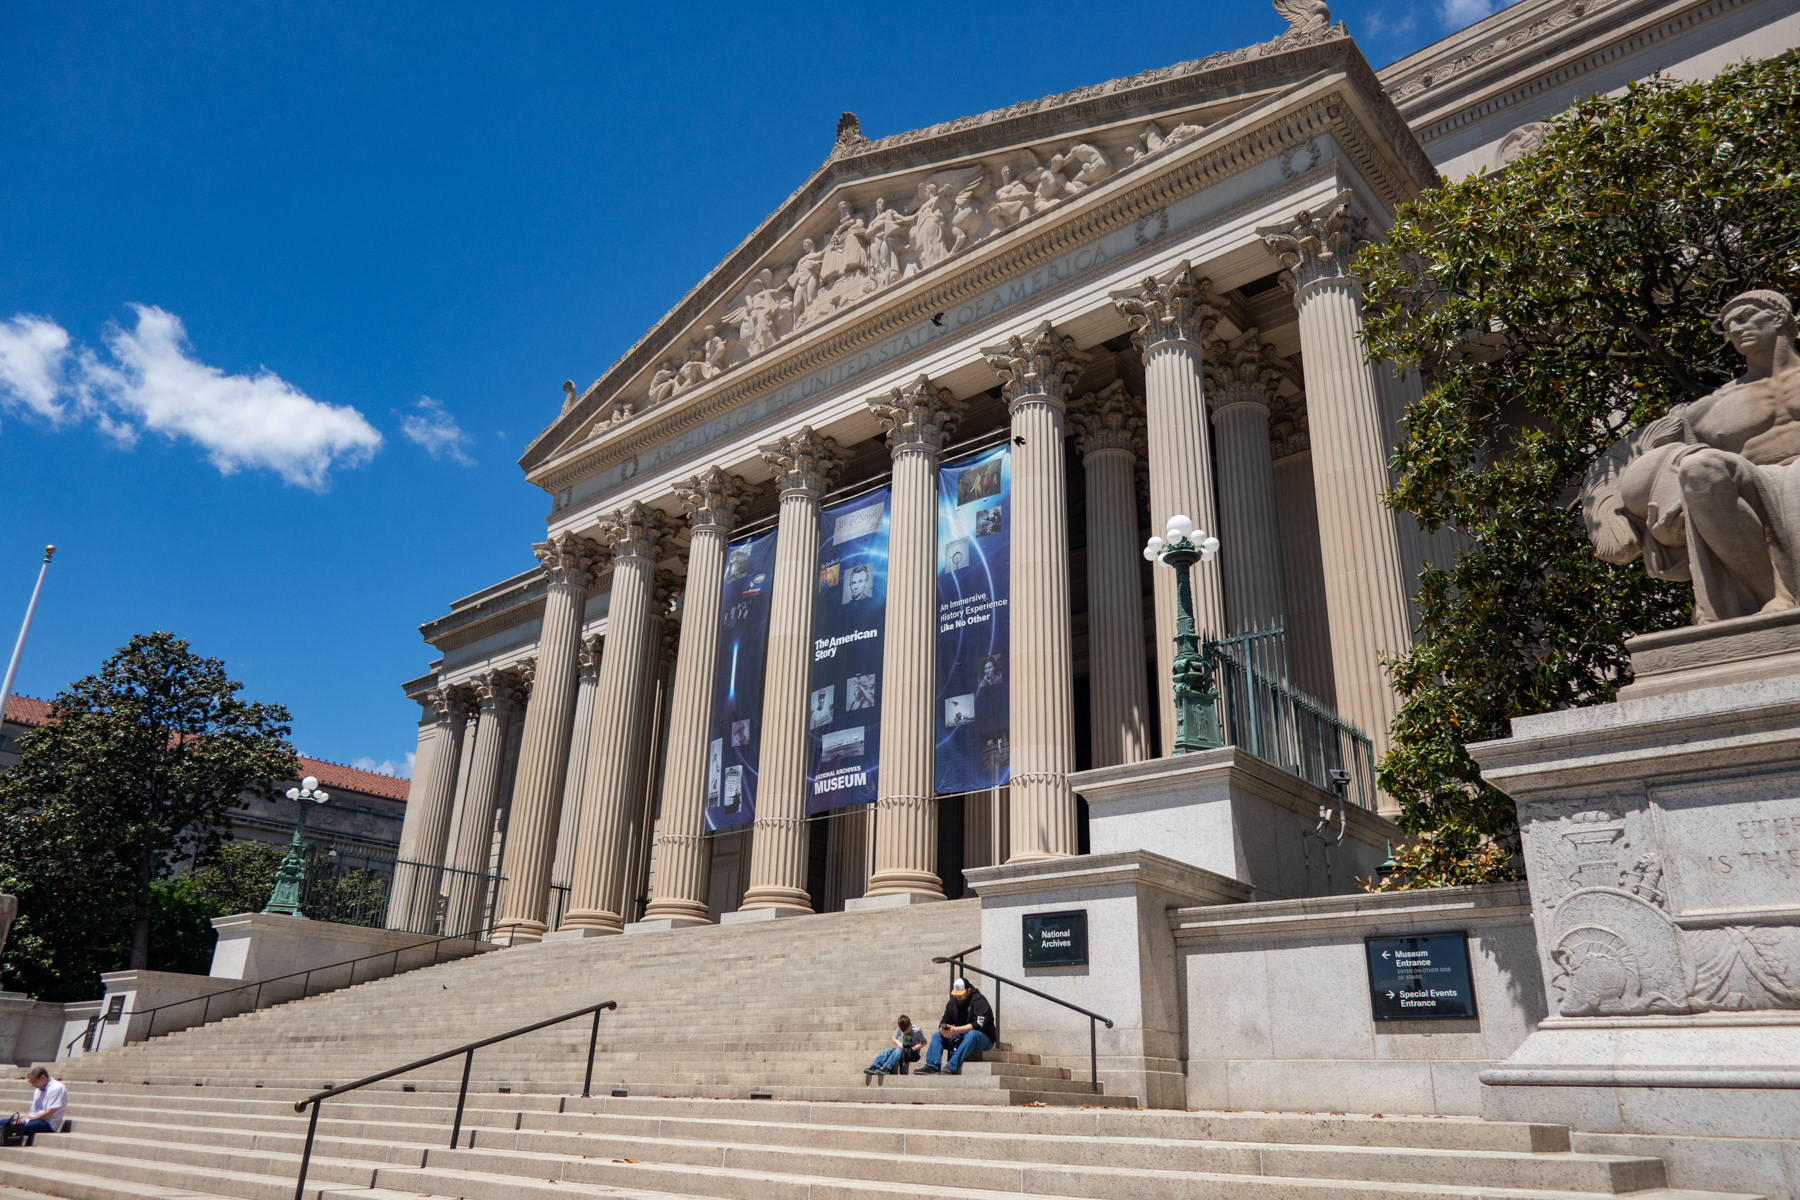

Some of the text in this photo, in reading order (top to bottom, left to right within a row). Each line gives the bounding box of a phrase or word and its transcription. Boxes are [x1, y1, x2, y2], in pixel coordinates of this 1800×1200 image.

[653, 243, 1108, 466] ARCHIVES OF THE UNITED STATES OF AMERICA
[940, 593, 987, 612] An Immersive
[940, 599, 1008, 622] History Experience
[940, 613, 991, 633] Like No Other
[815, 629, 878, 650] The American
[814, 646, 838, 661] Story
[836, 765, 862, 775] ARCHIVES
[814, 772, 867, 795] MUSEUM
[1708, 848, 1800, 875] IS THE
[1041, 928, 1071, 939] National
[1041, 939, 1071, 948] Archives
[1394, 950, 1429, 958] Museum
[1395, 959, 1432, 967] Entrance
[1399, 989, 1458, 999] Special Events
[1400, 999, 1437, 1008] Entrance
